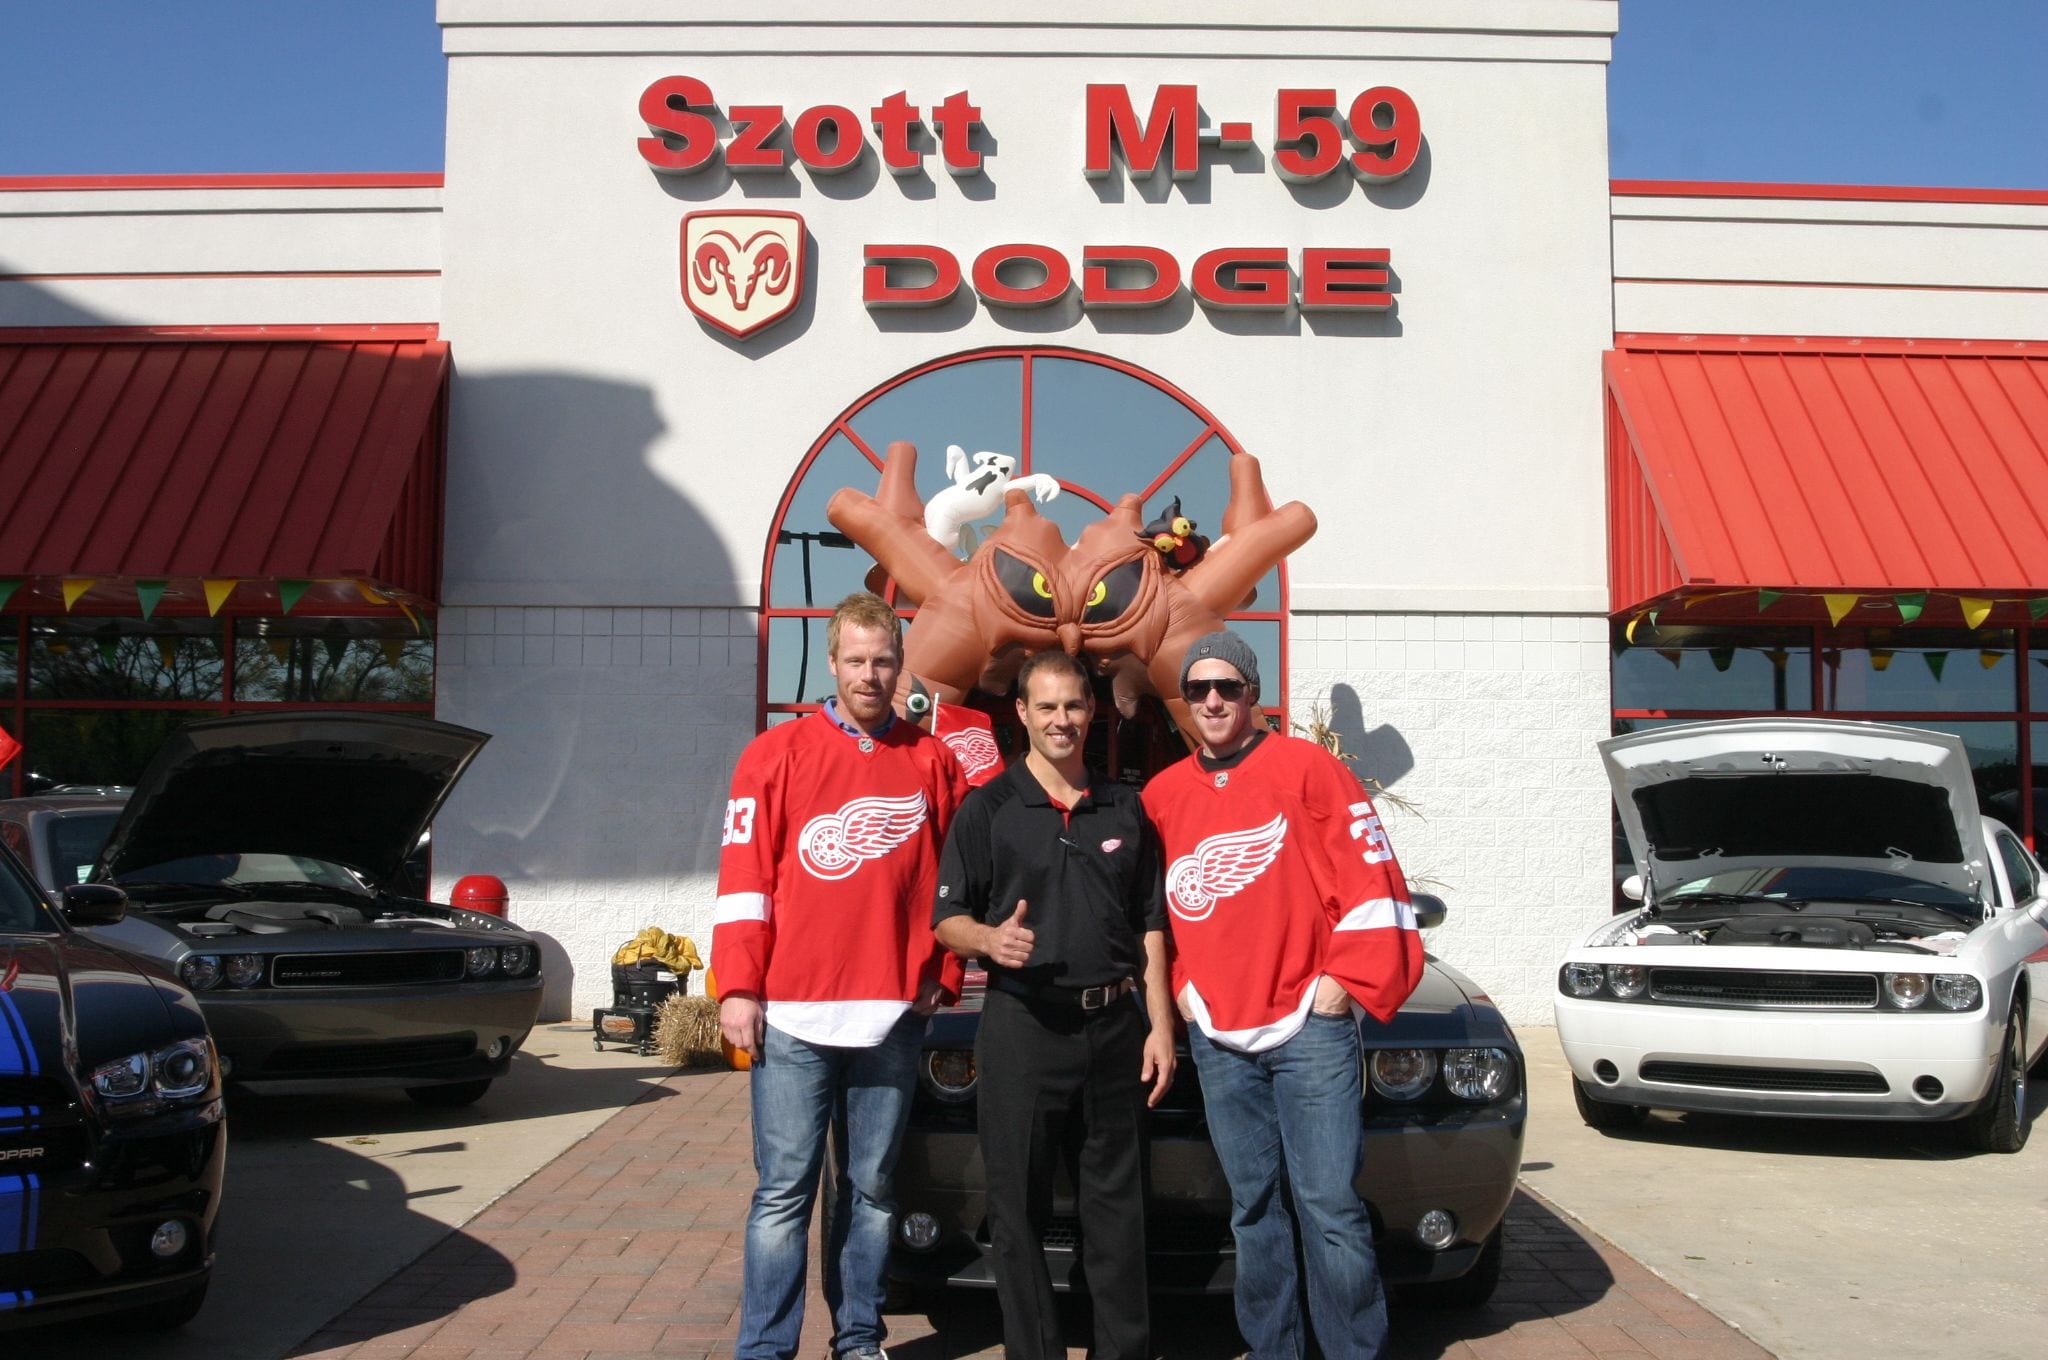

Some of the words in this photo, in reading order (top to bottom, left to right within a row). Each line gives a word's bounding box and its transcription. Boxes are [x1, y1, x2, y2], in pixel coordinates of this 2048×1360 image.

[637, 75, 982, 178] Szott
[1085, 83, 1421, 182] M-59
[863, 243, 1393, 308] DODGE
[721, 797, 757, 847] 93
